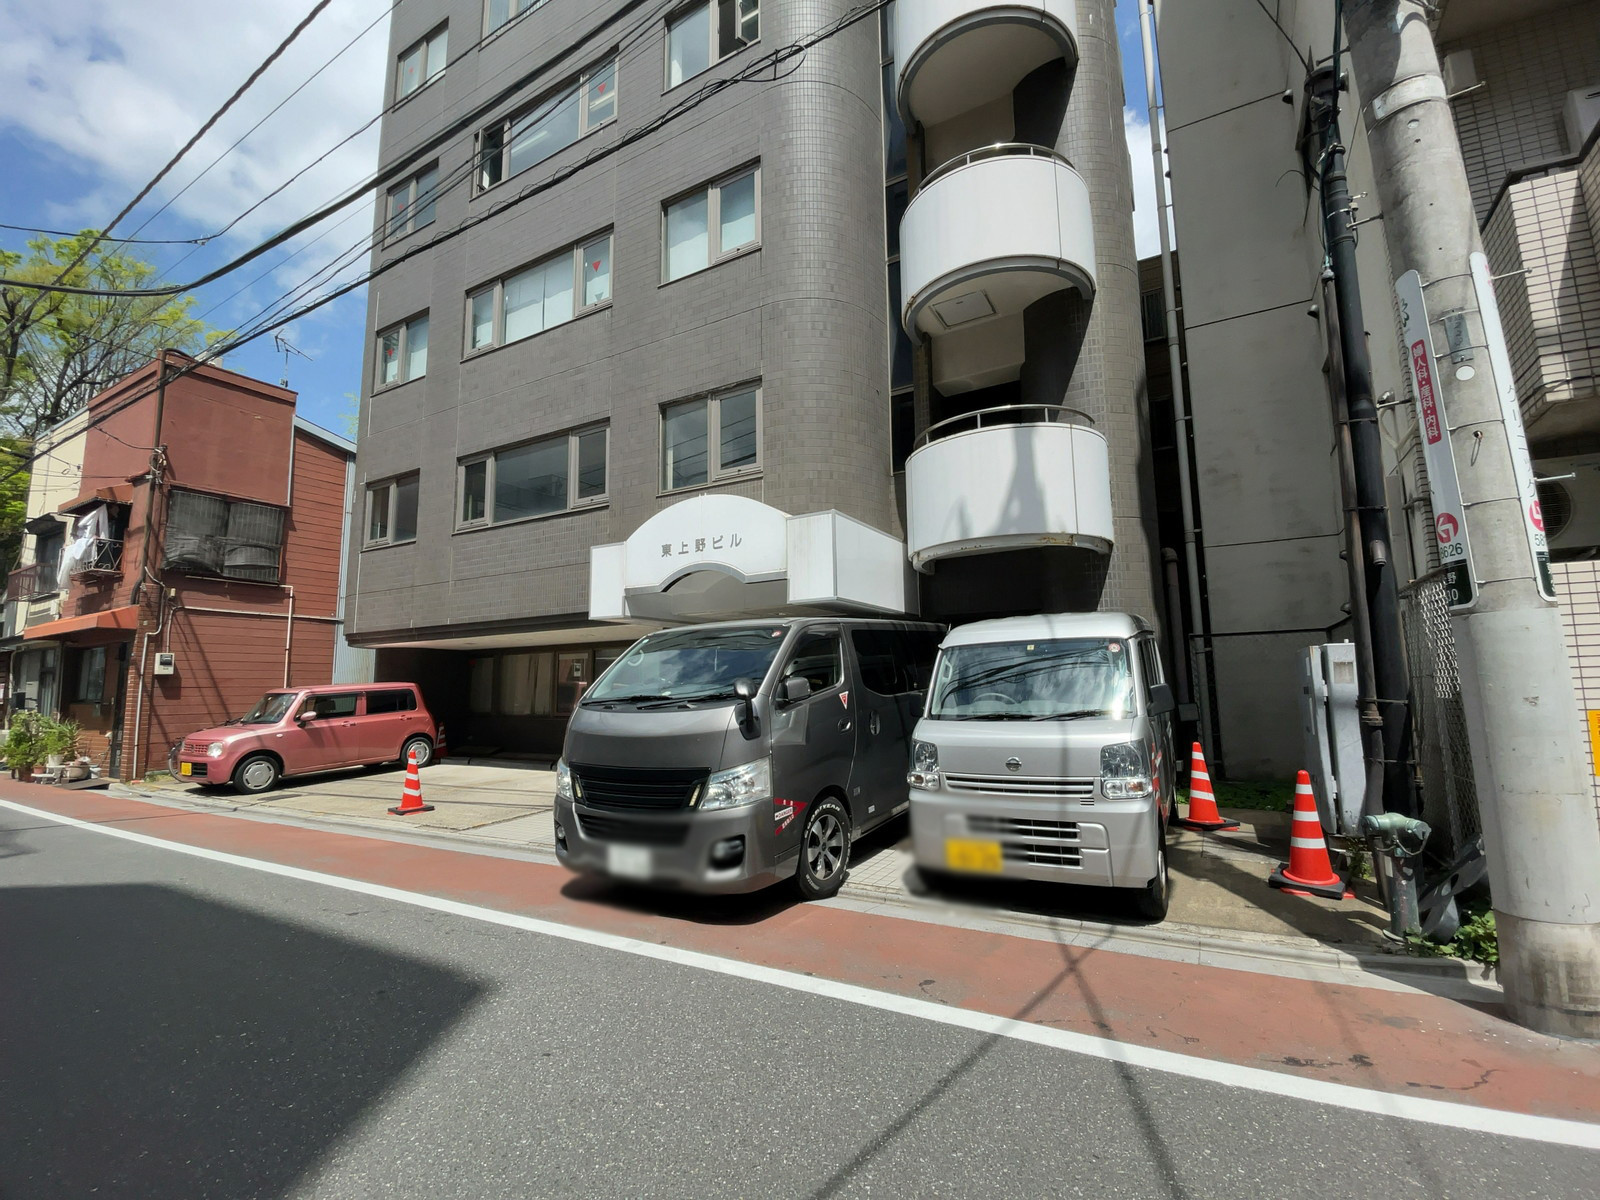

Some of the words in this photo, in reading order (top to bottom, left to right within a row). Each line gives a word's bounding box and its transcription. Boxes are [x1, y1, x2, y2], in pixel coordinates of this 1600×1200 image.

[661, 533, 742, 558] 東上野ビル
